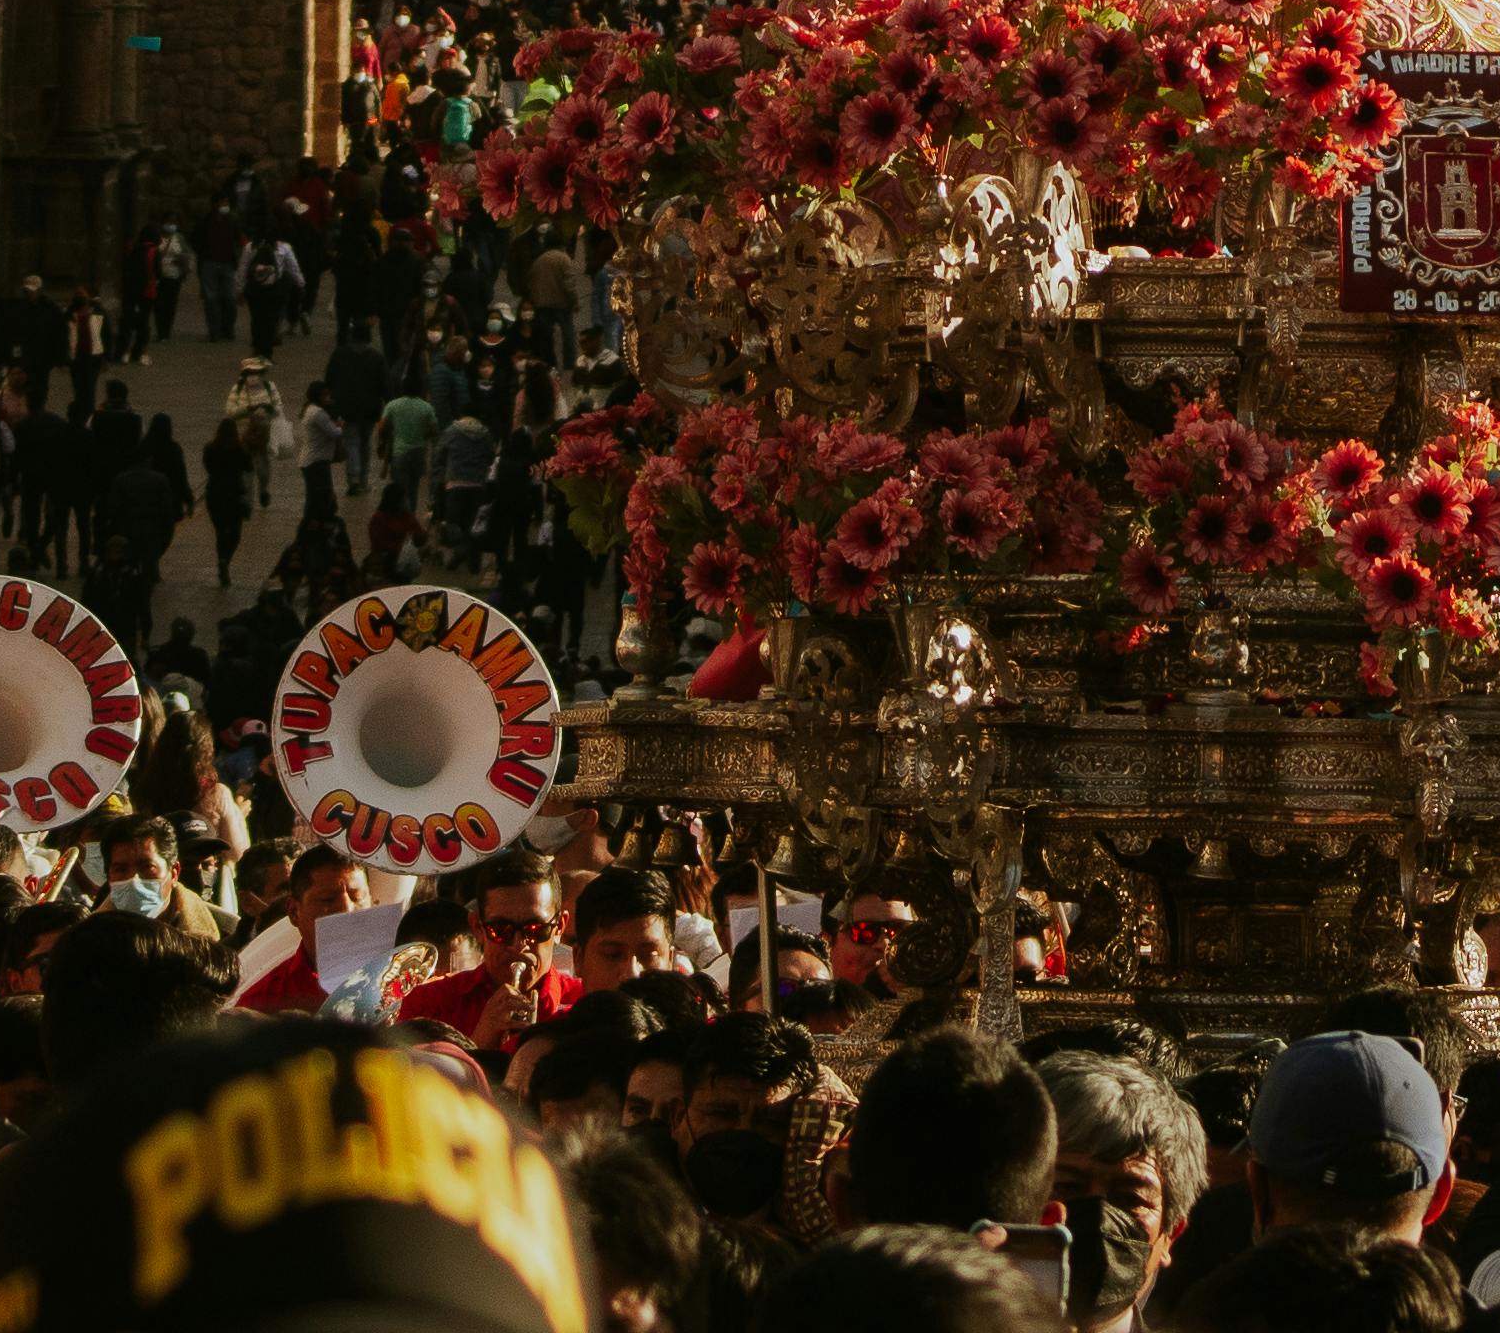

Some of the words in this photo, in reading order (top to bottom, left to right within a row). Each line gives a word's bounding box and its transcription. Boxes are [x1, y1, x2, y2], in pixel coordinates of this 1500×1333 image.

[1367, 50, 1387, 72] Y
[1391, 53, 1470, 75] MADRE
[1393, 290, 1418, 311] 28
[30, 597, 144, 763] AMARU
[280, 594, 397, 777] TUPAC
[438, 601, 555, 807] AMARU
[310, 787, 501, 869] CUSCO
